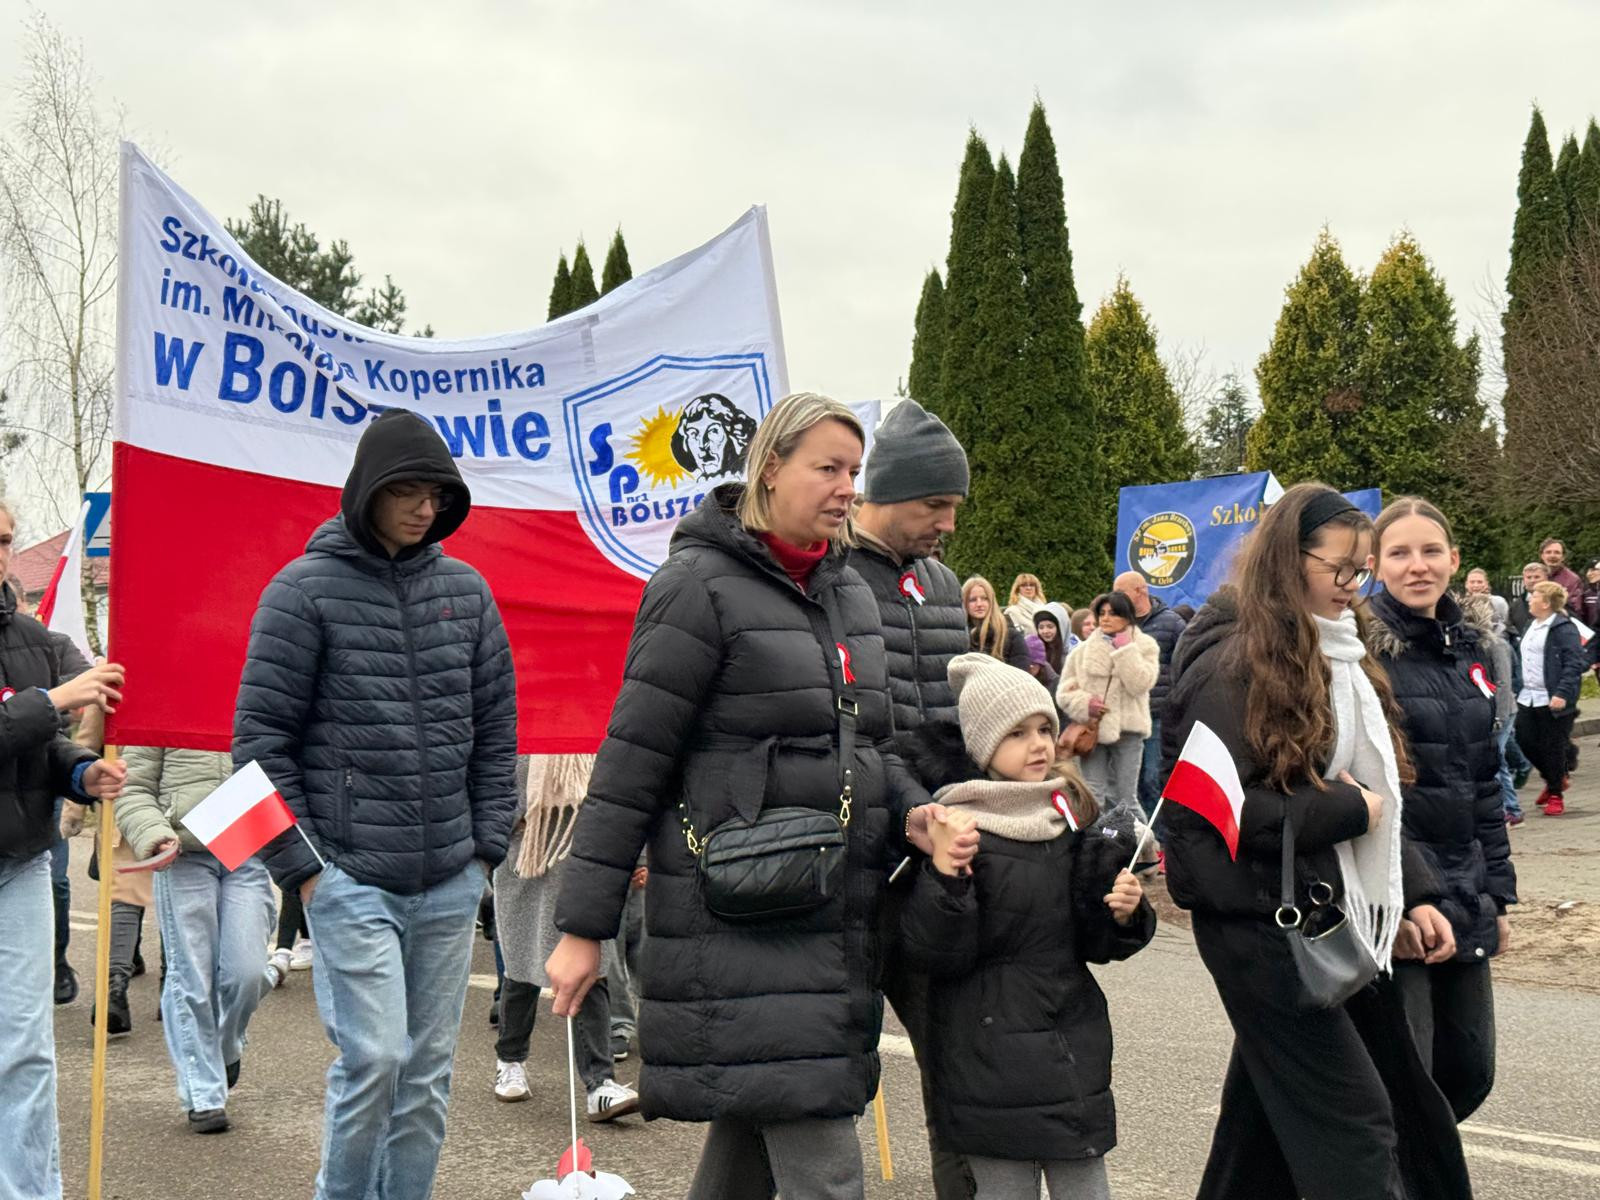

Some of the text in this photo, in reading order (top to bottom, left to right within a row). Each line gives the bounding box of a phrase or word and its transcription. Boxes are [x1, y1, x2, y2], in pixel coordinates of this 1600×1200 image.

[160, 268, 210, 315] im.
[364, 357, 546, 400] Kopernika
[218, 331, 552, 461] Bolswie
